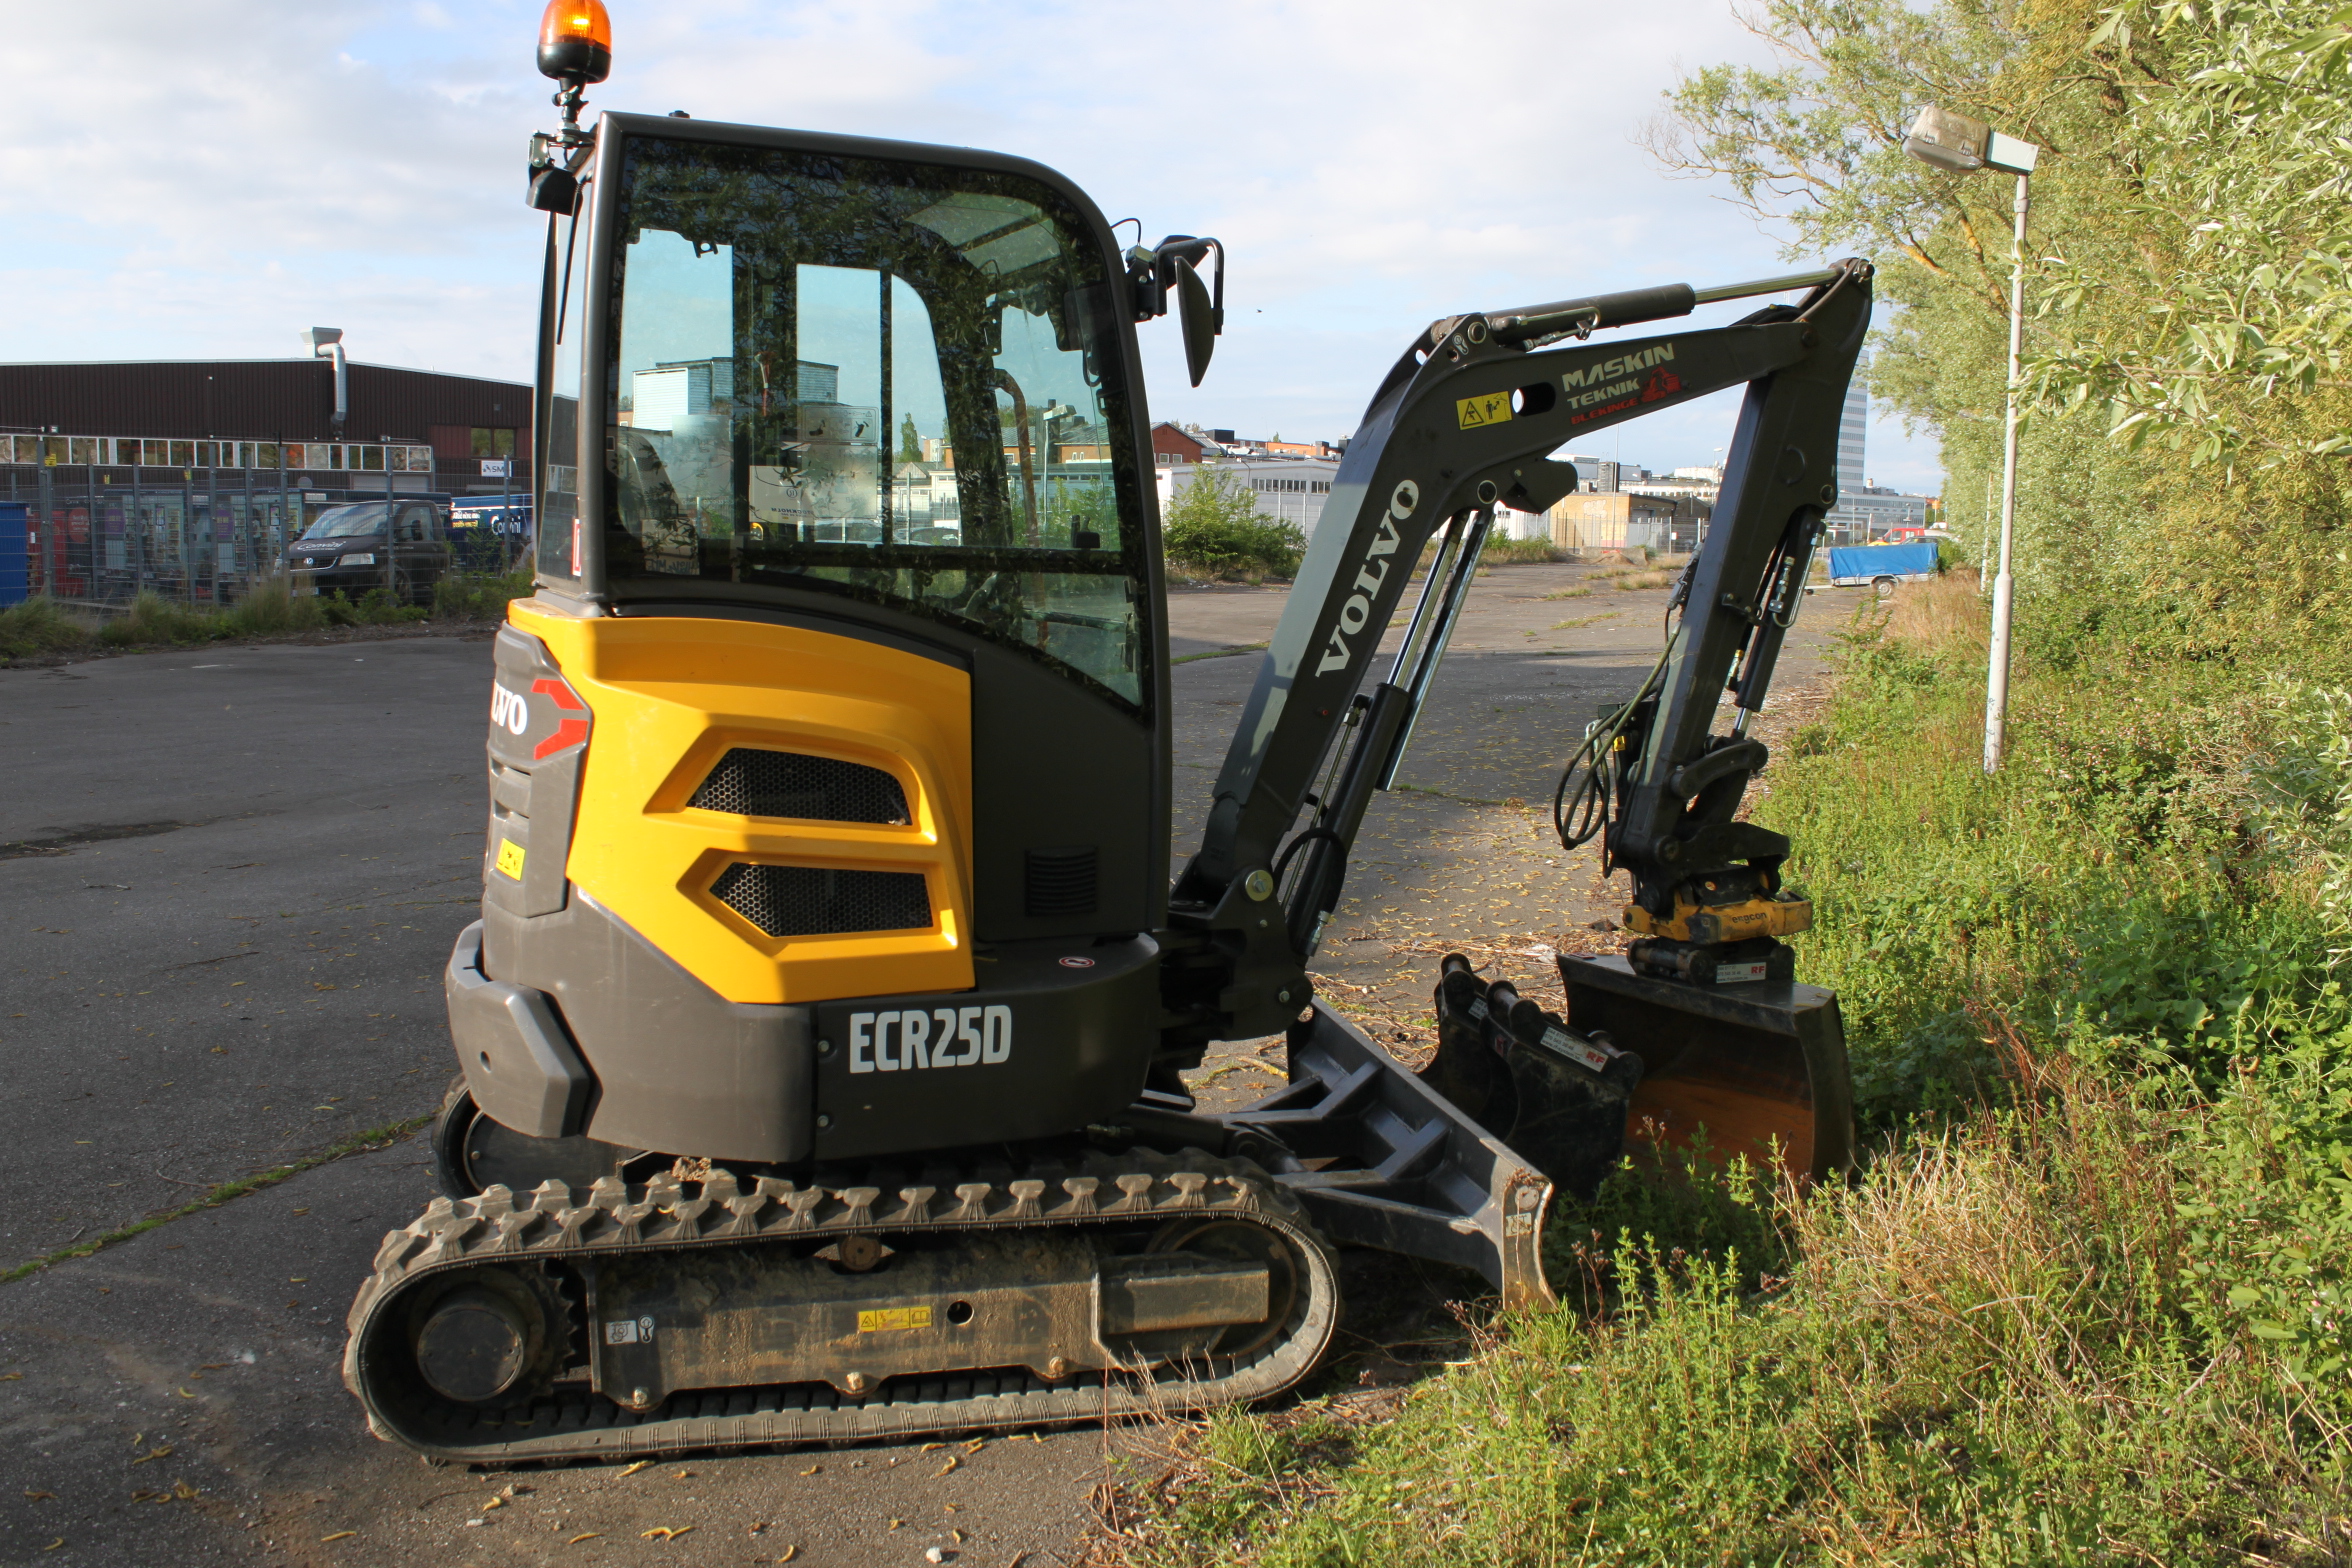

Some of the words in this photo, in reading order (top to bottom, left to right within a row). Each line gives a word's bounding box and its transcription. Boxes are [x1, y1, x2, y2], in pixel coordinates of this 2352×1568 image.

[1562, 342, 1675, 392] MASKIN
[1567, 377, 1640, 410] TEKNIK
[1571, 397, 1639, 425] BLEKINGE
[1315, 479, 1419, 678] VOLVO
[1751, 966, 1765, 974] RF
[850, 1005, 1012, 1074] ECR25D
[1586, 1050, 1605, 1064] RF
